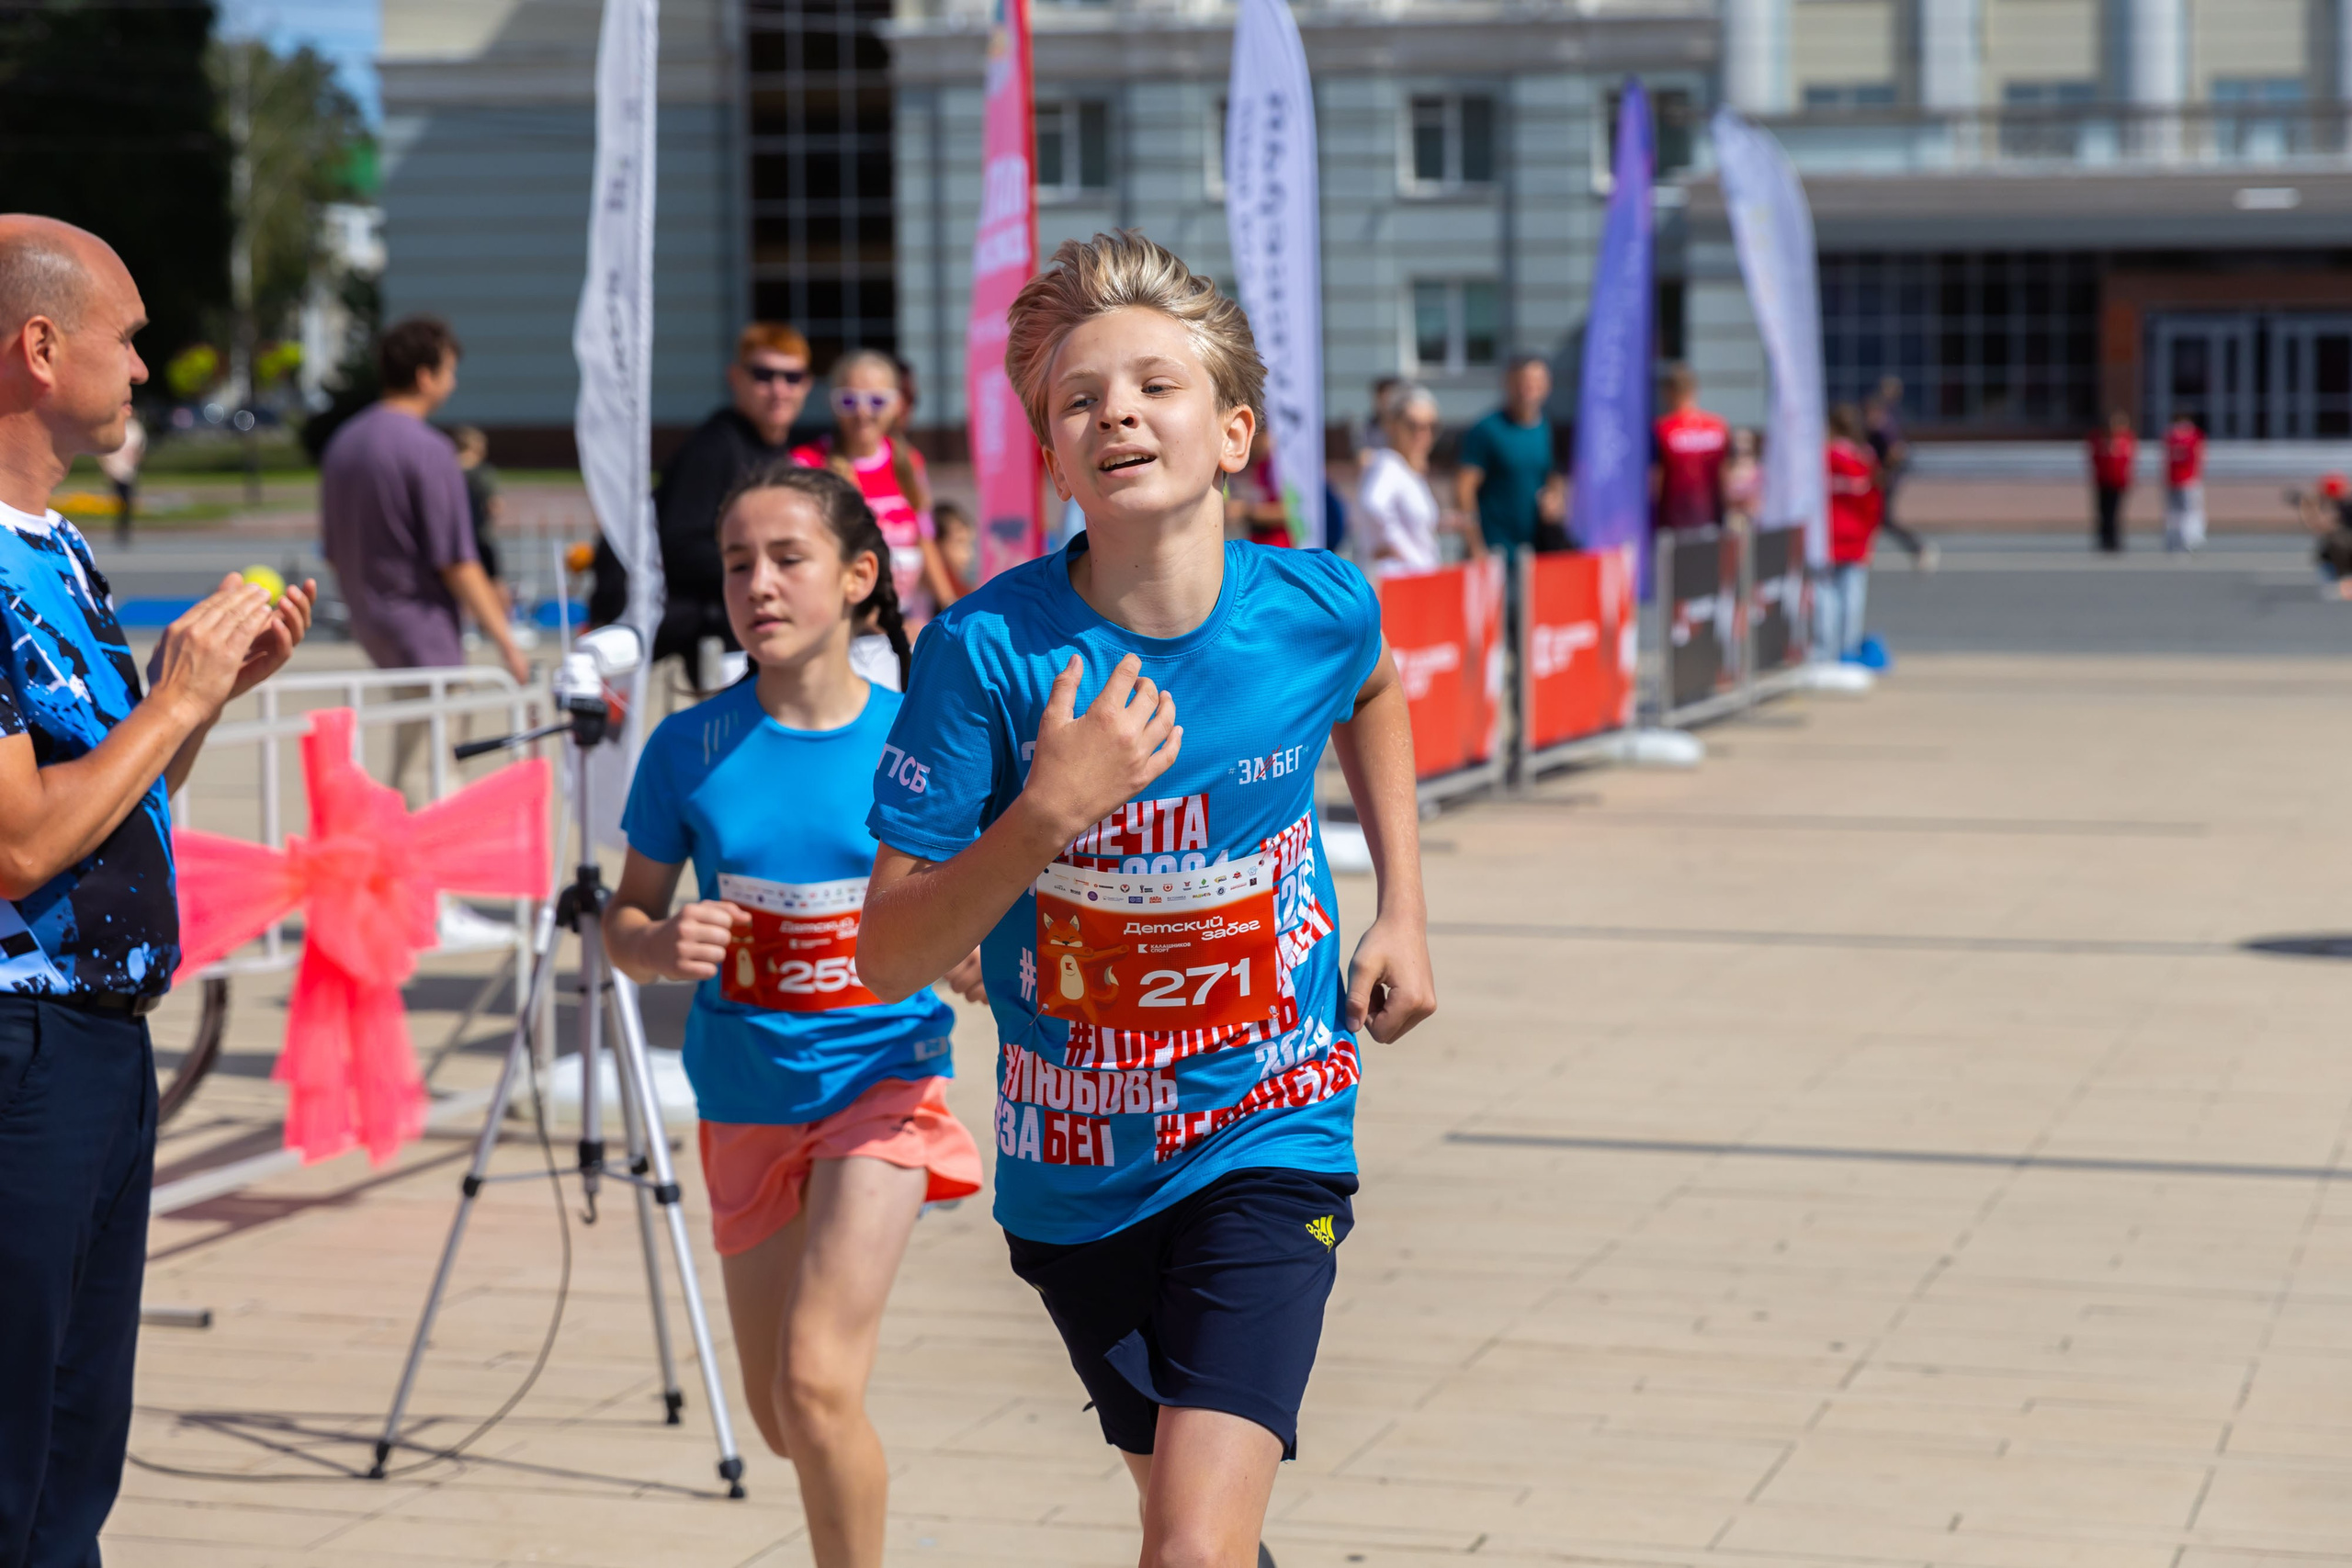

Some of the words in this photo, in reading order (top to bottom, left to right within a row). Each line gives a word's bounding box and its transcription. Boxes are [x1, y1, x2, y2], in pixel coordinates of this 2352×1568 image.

[876, 743, 931, 794] ПСБ
[1124, 916, 1223, 935] Детский
[1201, 919, 1261, 942] забег
[1138, 957, 1250, 1008] 271
